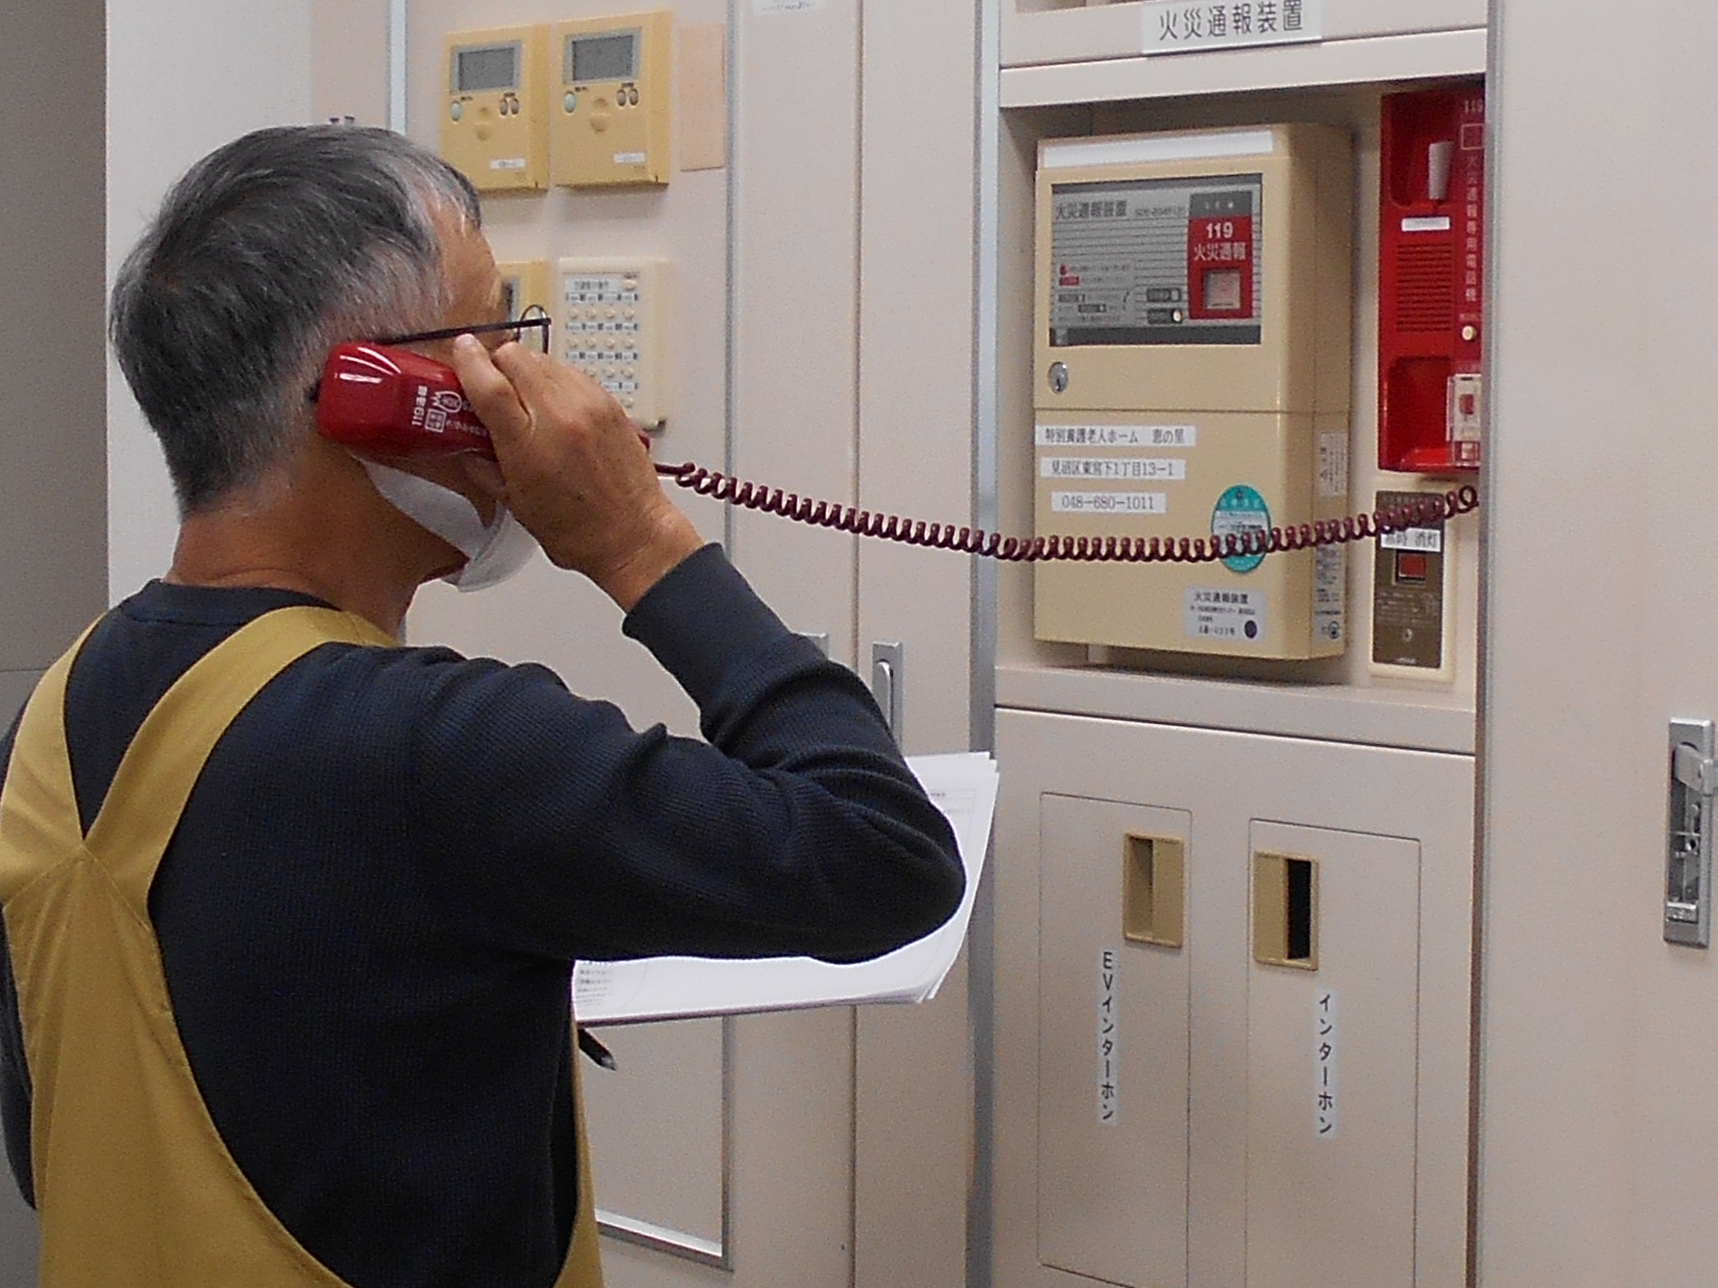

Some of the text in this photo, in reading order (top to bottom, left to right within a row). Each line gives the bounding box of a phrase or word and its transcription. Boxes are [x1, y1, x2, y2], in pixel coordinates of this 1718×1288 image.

[1055, 199, 1128, 220] 火災通報装置
[1205, 221, 1235, 240] 119
[1193, 242, 1247, 262] 火災通報
[1044, 428, 1186, 445] 特別養護老人ホーム 恵の里
[1100, 950, 1115, 1121] EVインターホン
[1318, 993, 1333, 1135] インターホン
